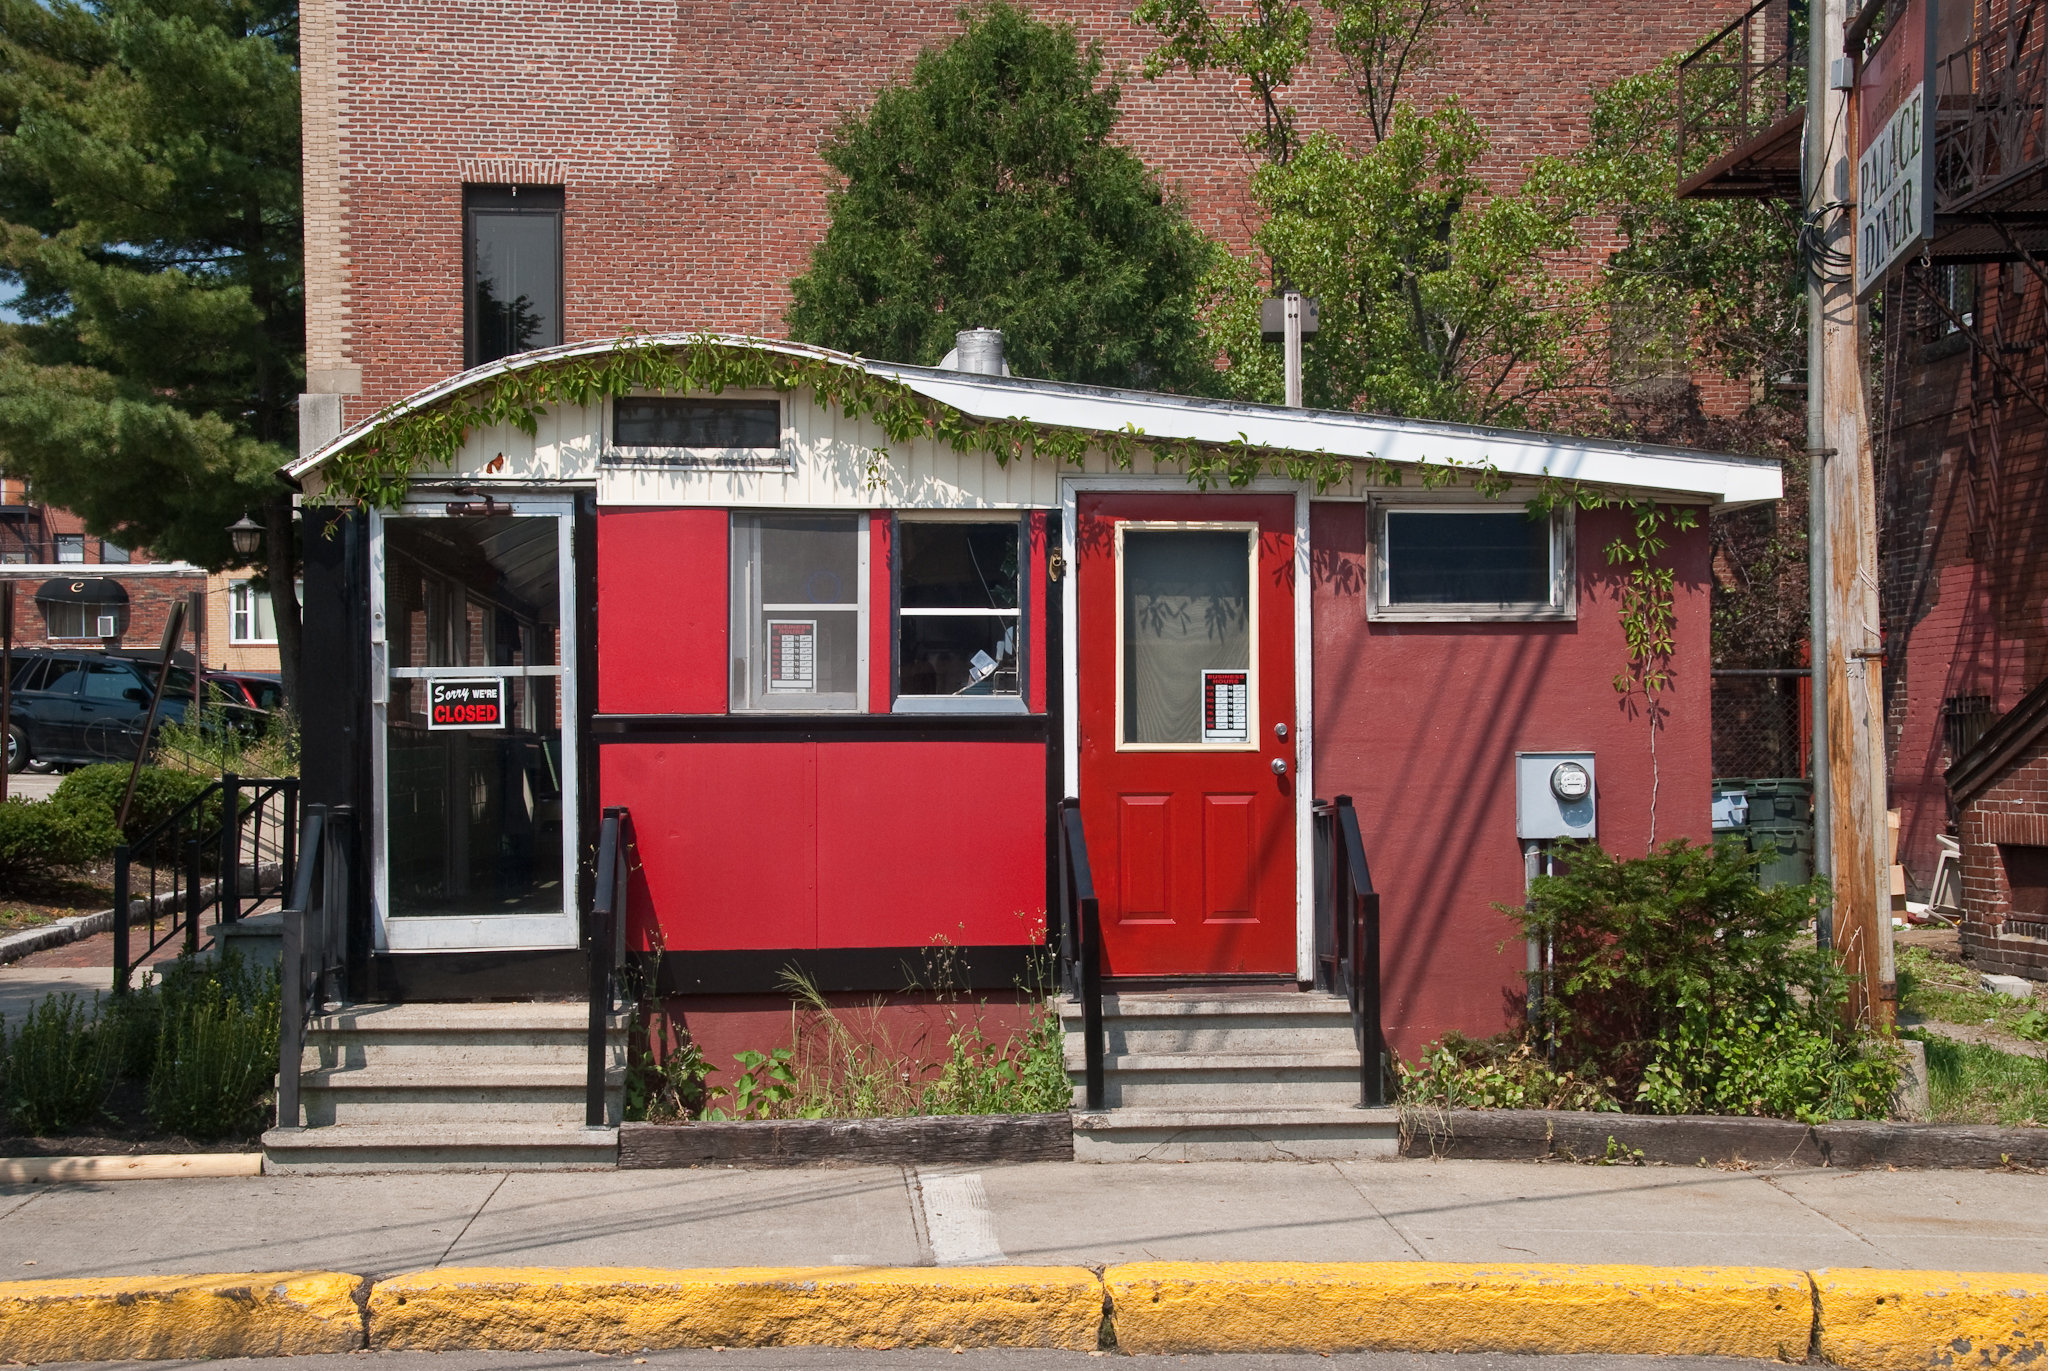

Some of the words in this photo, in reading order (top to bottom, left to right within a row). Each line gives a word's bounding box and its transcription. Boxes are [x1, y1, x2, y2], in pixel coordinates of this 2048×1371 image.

[1870, 85, 1893, 134] OLDEST
[1860, 92, 1922, 220] PALACE
[1864, 178, 1914, 281] DINER
[434, 685, 470, 703] Sorry
[472, 689, 498, 699] WE'RE
[434, 704, 498, 723] CLOSED
